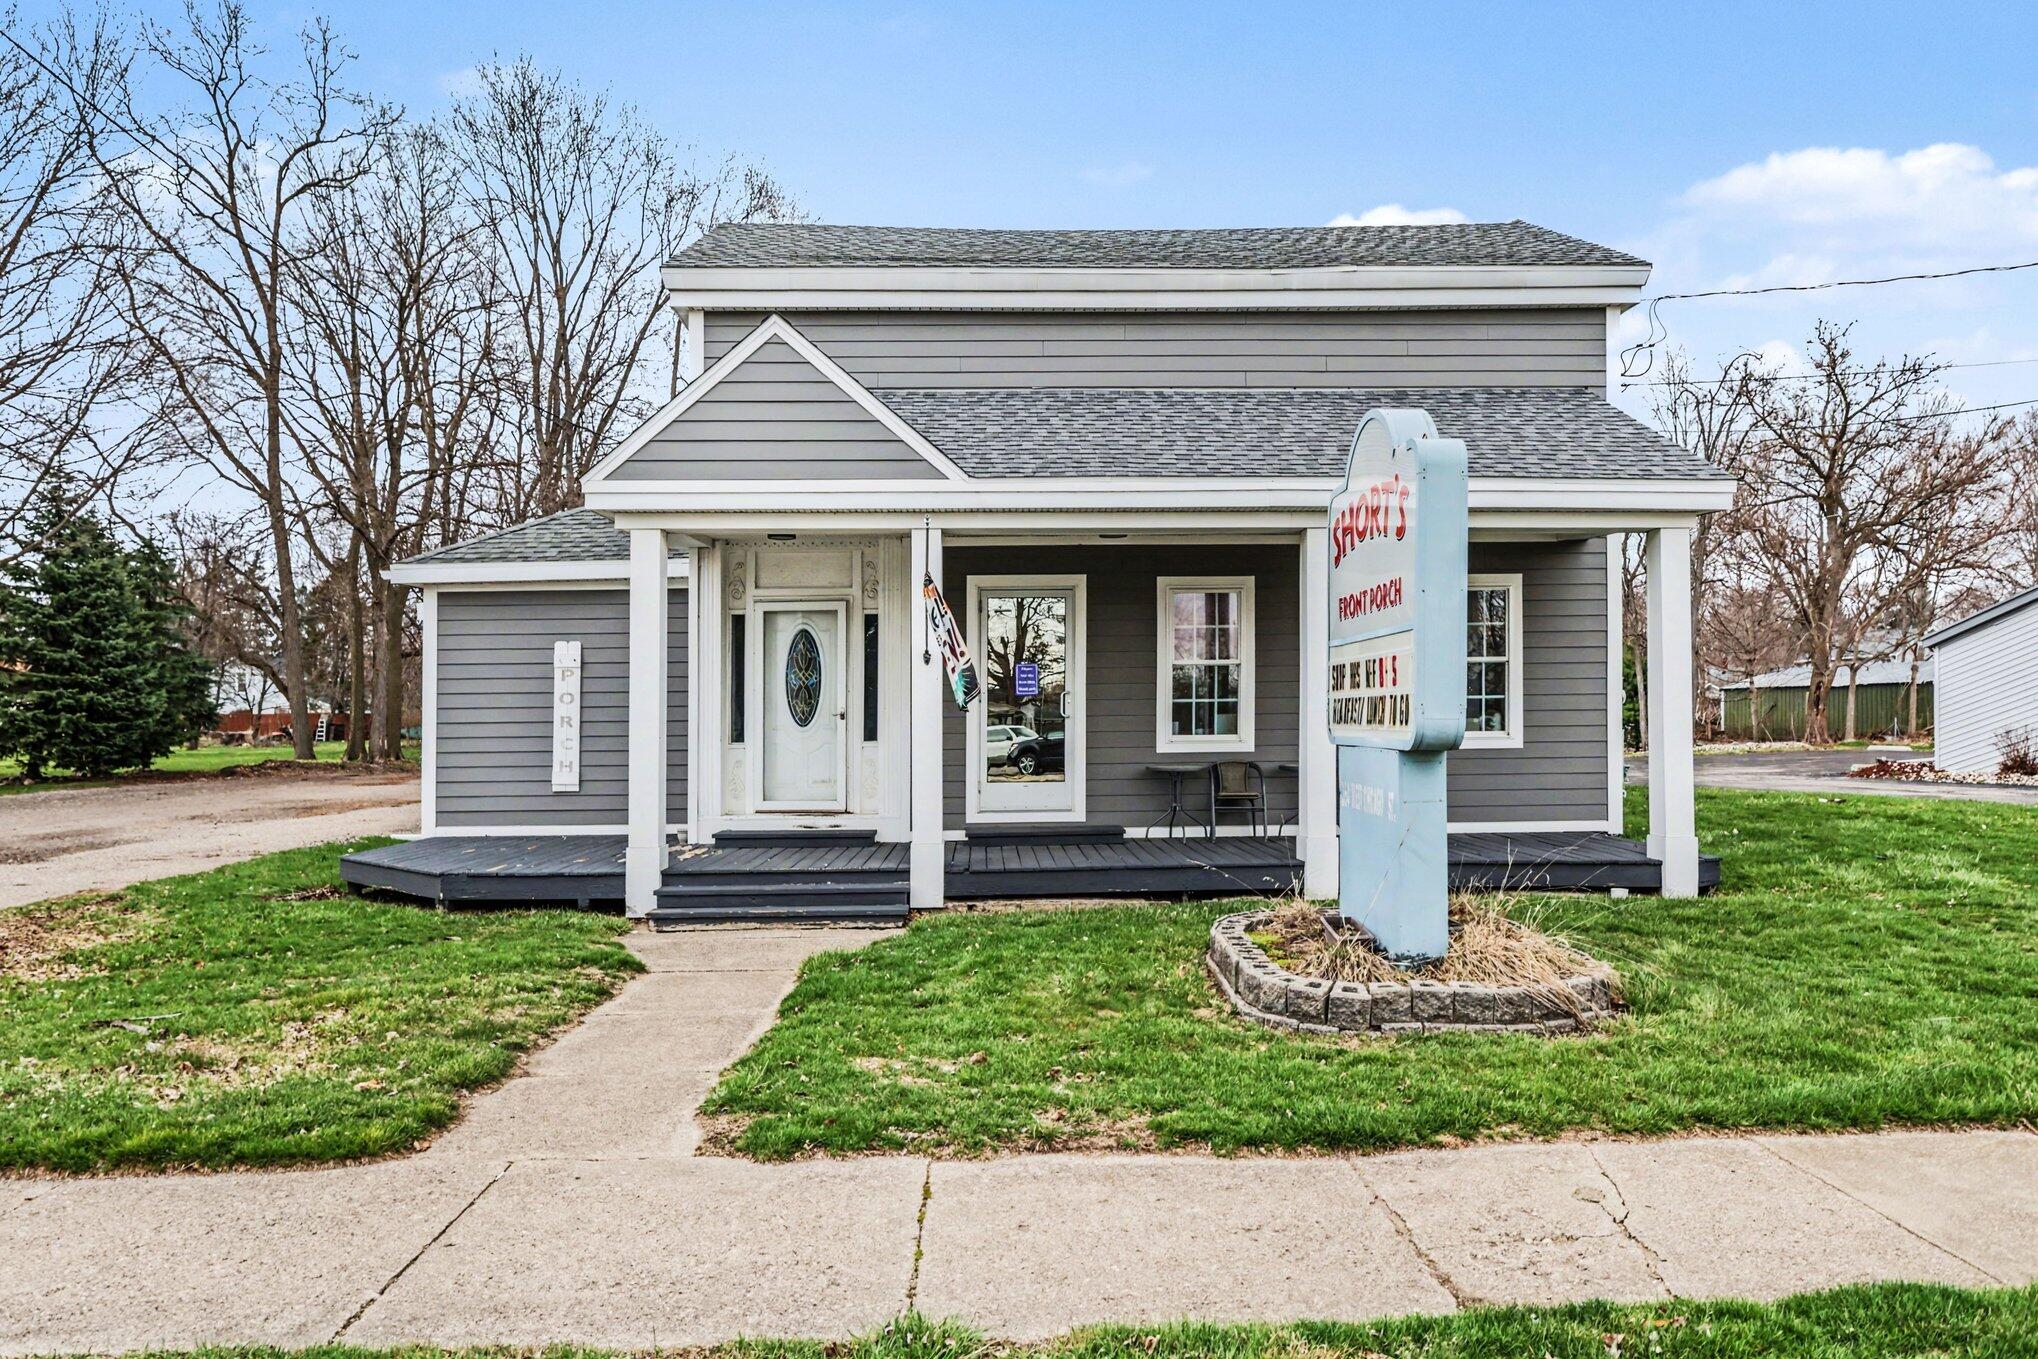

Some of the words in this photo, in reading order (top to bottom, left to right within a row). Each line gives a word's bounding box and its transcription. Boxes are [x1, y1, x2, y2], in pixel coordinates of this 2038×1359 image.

[1333, 473, 1409, 568] SHORT'S
[1339, 590, 1368, 622] FRONT
[1370, 577, 1401, 613] PORCH
[559, 669, 574, 773] PORCH
